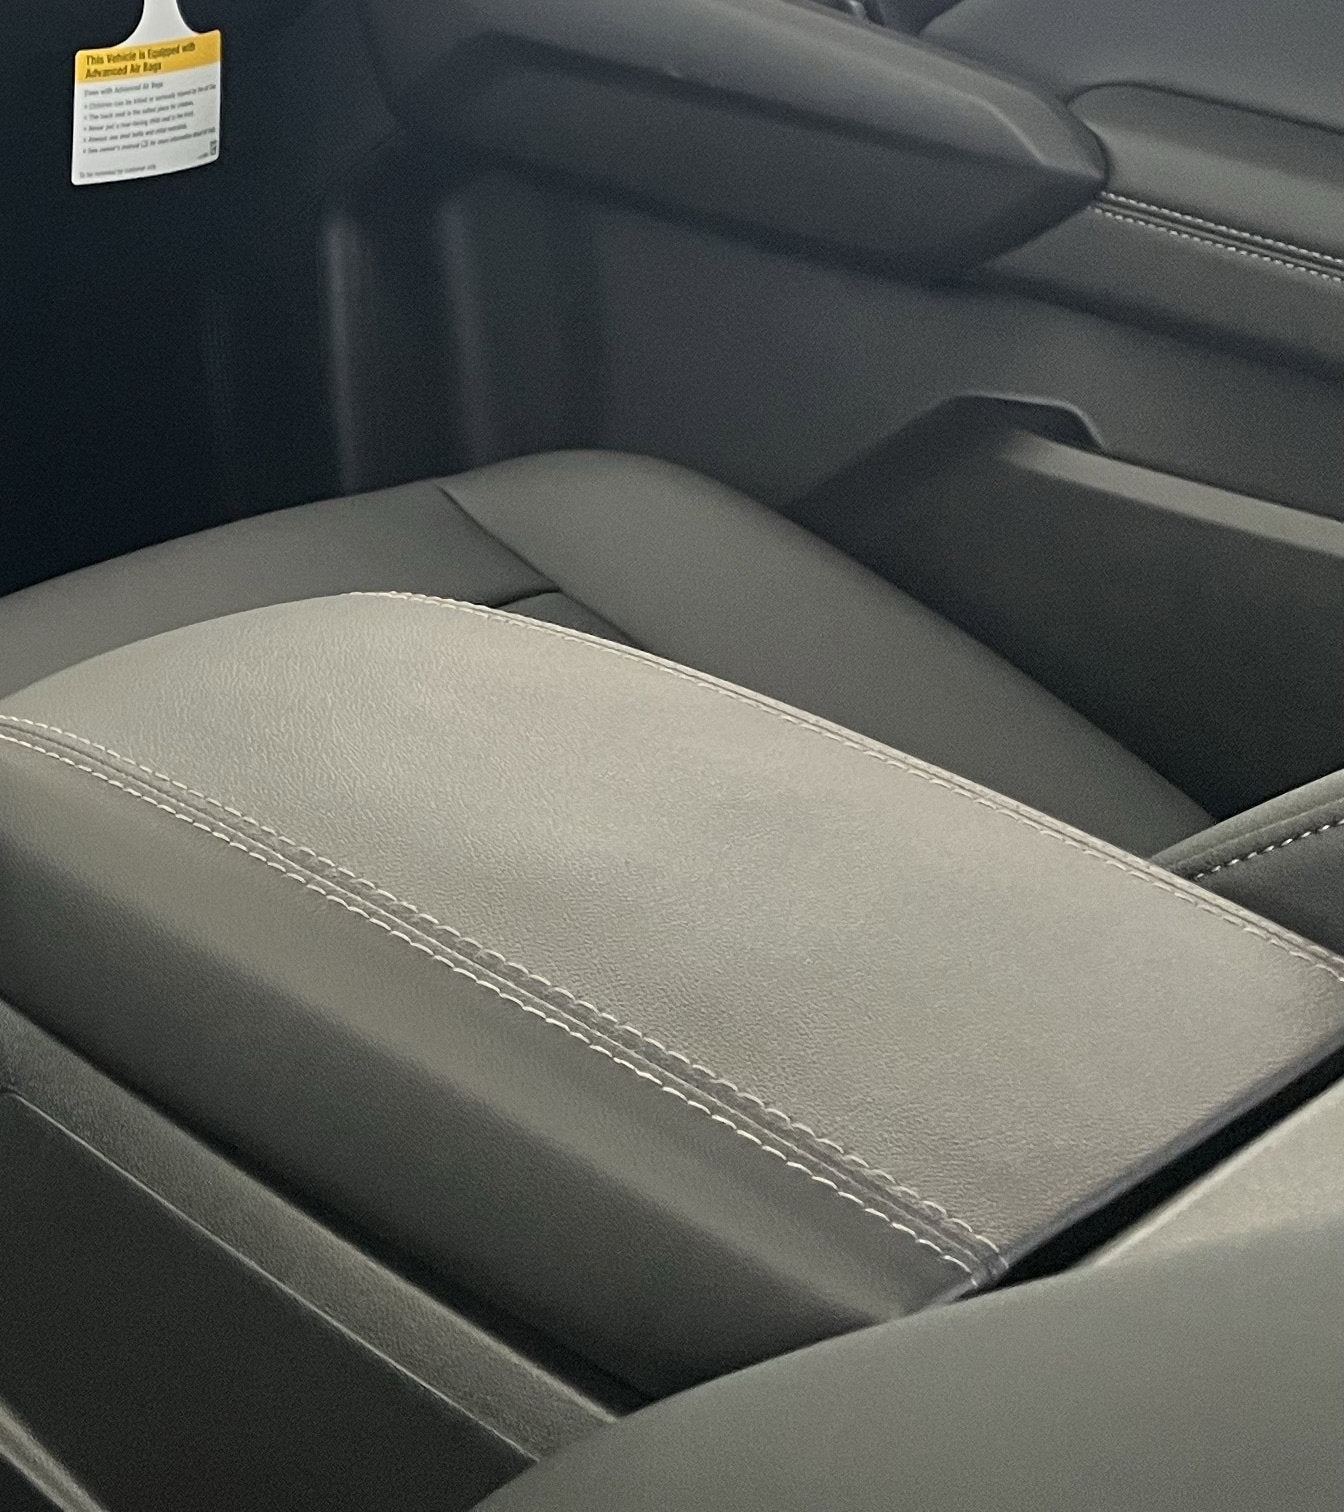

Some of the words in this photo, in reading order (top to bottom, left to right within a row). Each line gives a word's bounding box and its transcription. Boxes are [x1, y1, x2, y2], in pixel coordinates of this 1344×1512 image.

[86, 54, 104, 66] This
[107, 51, 136, 63] Vehicle
[147, 44, 180, 59] Equipped
[85, 64, 127, 79] Advanced
[130, 63, 141, 74] Air
[143, 61, 162, 74] Bags
